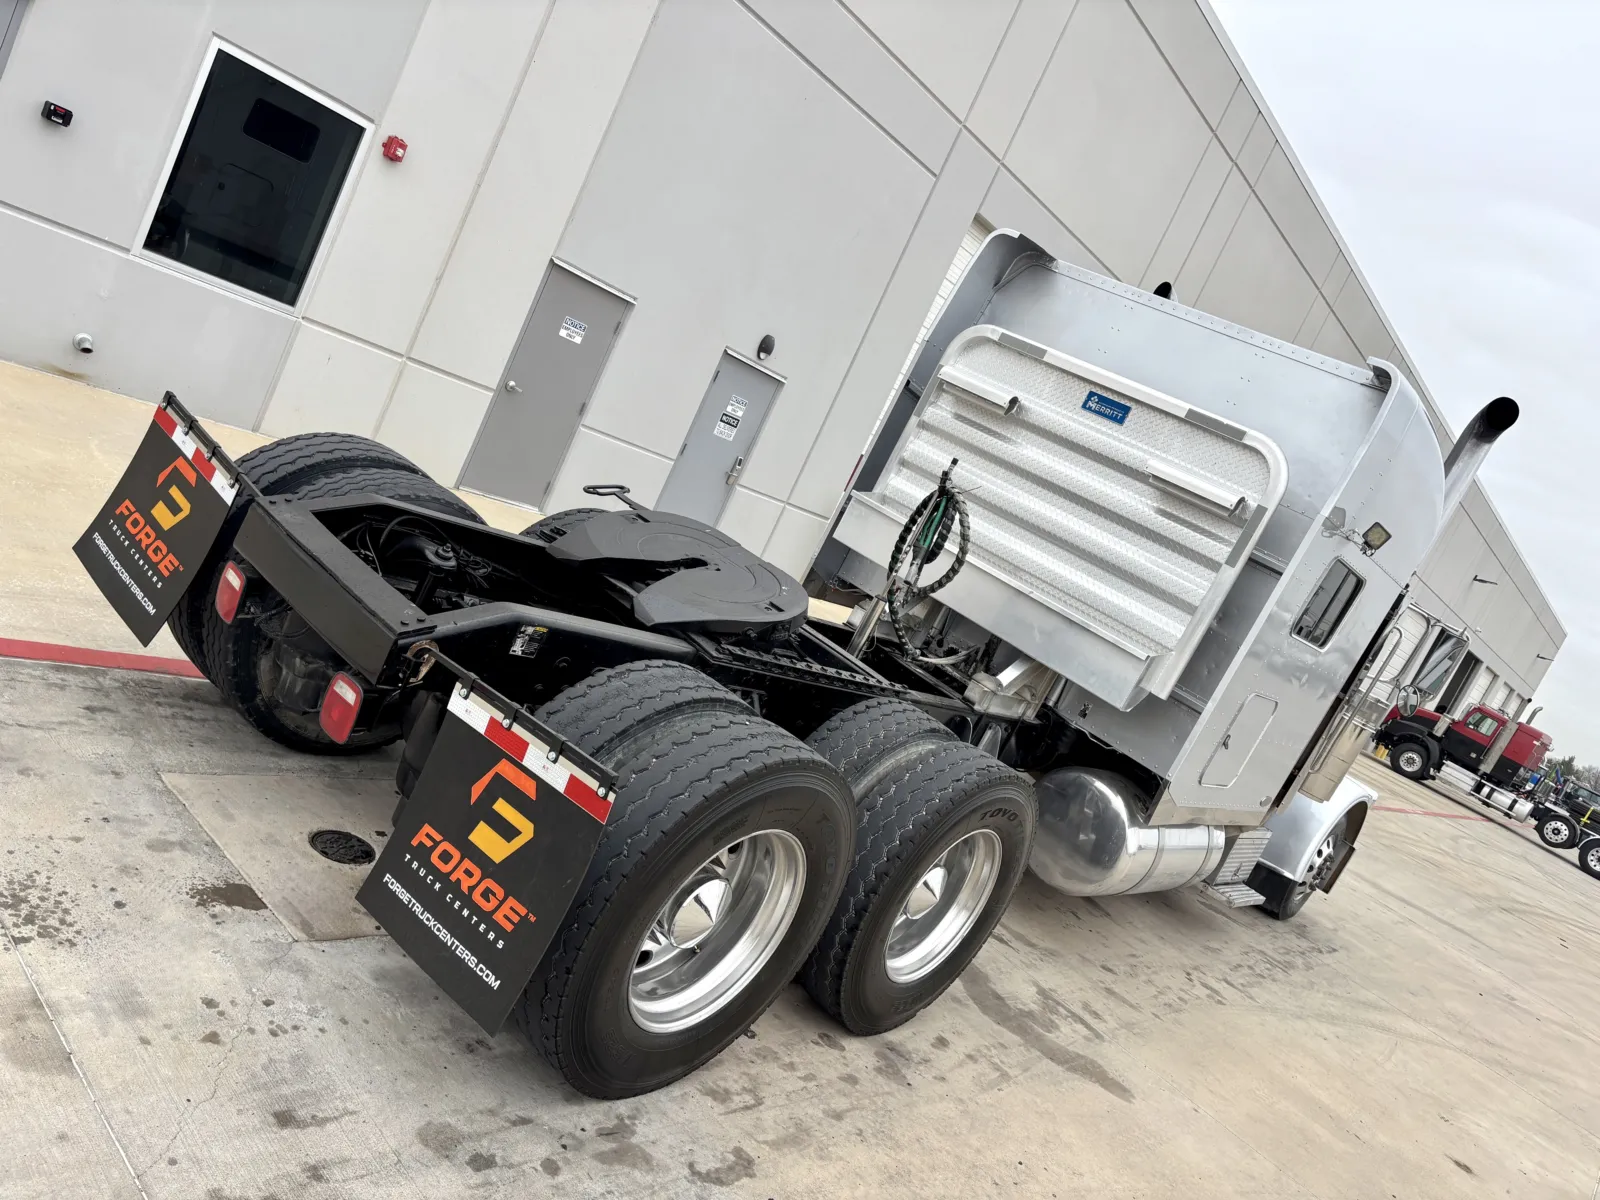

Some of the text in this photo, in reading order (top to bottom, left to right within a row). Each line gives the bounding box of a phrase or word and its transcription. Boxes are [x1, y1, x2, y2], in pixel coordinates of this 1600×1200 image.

[565, 317, 586, 332] NOTICE
[565, 332, 576, 340] ONLY
[721, 415, 738, 426] NOTICE
[1086, 400, 1123, 420] MERRITT
[92, 532, 157, 616] FORGETRUCKCENTERS.COM
[109, 519, 163, 589] TRUCK CENTERS
[115, 499, 180, 578] FORGE
[404, 854, 505, 949] TRUCK CENTERS
[410, 823, 528, 932] FORGE
[382, 873, 501, 990] FORGETRUCKCENTERS.COM
